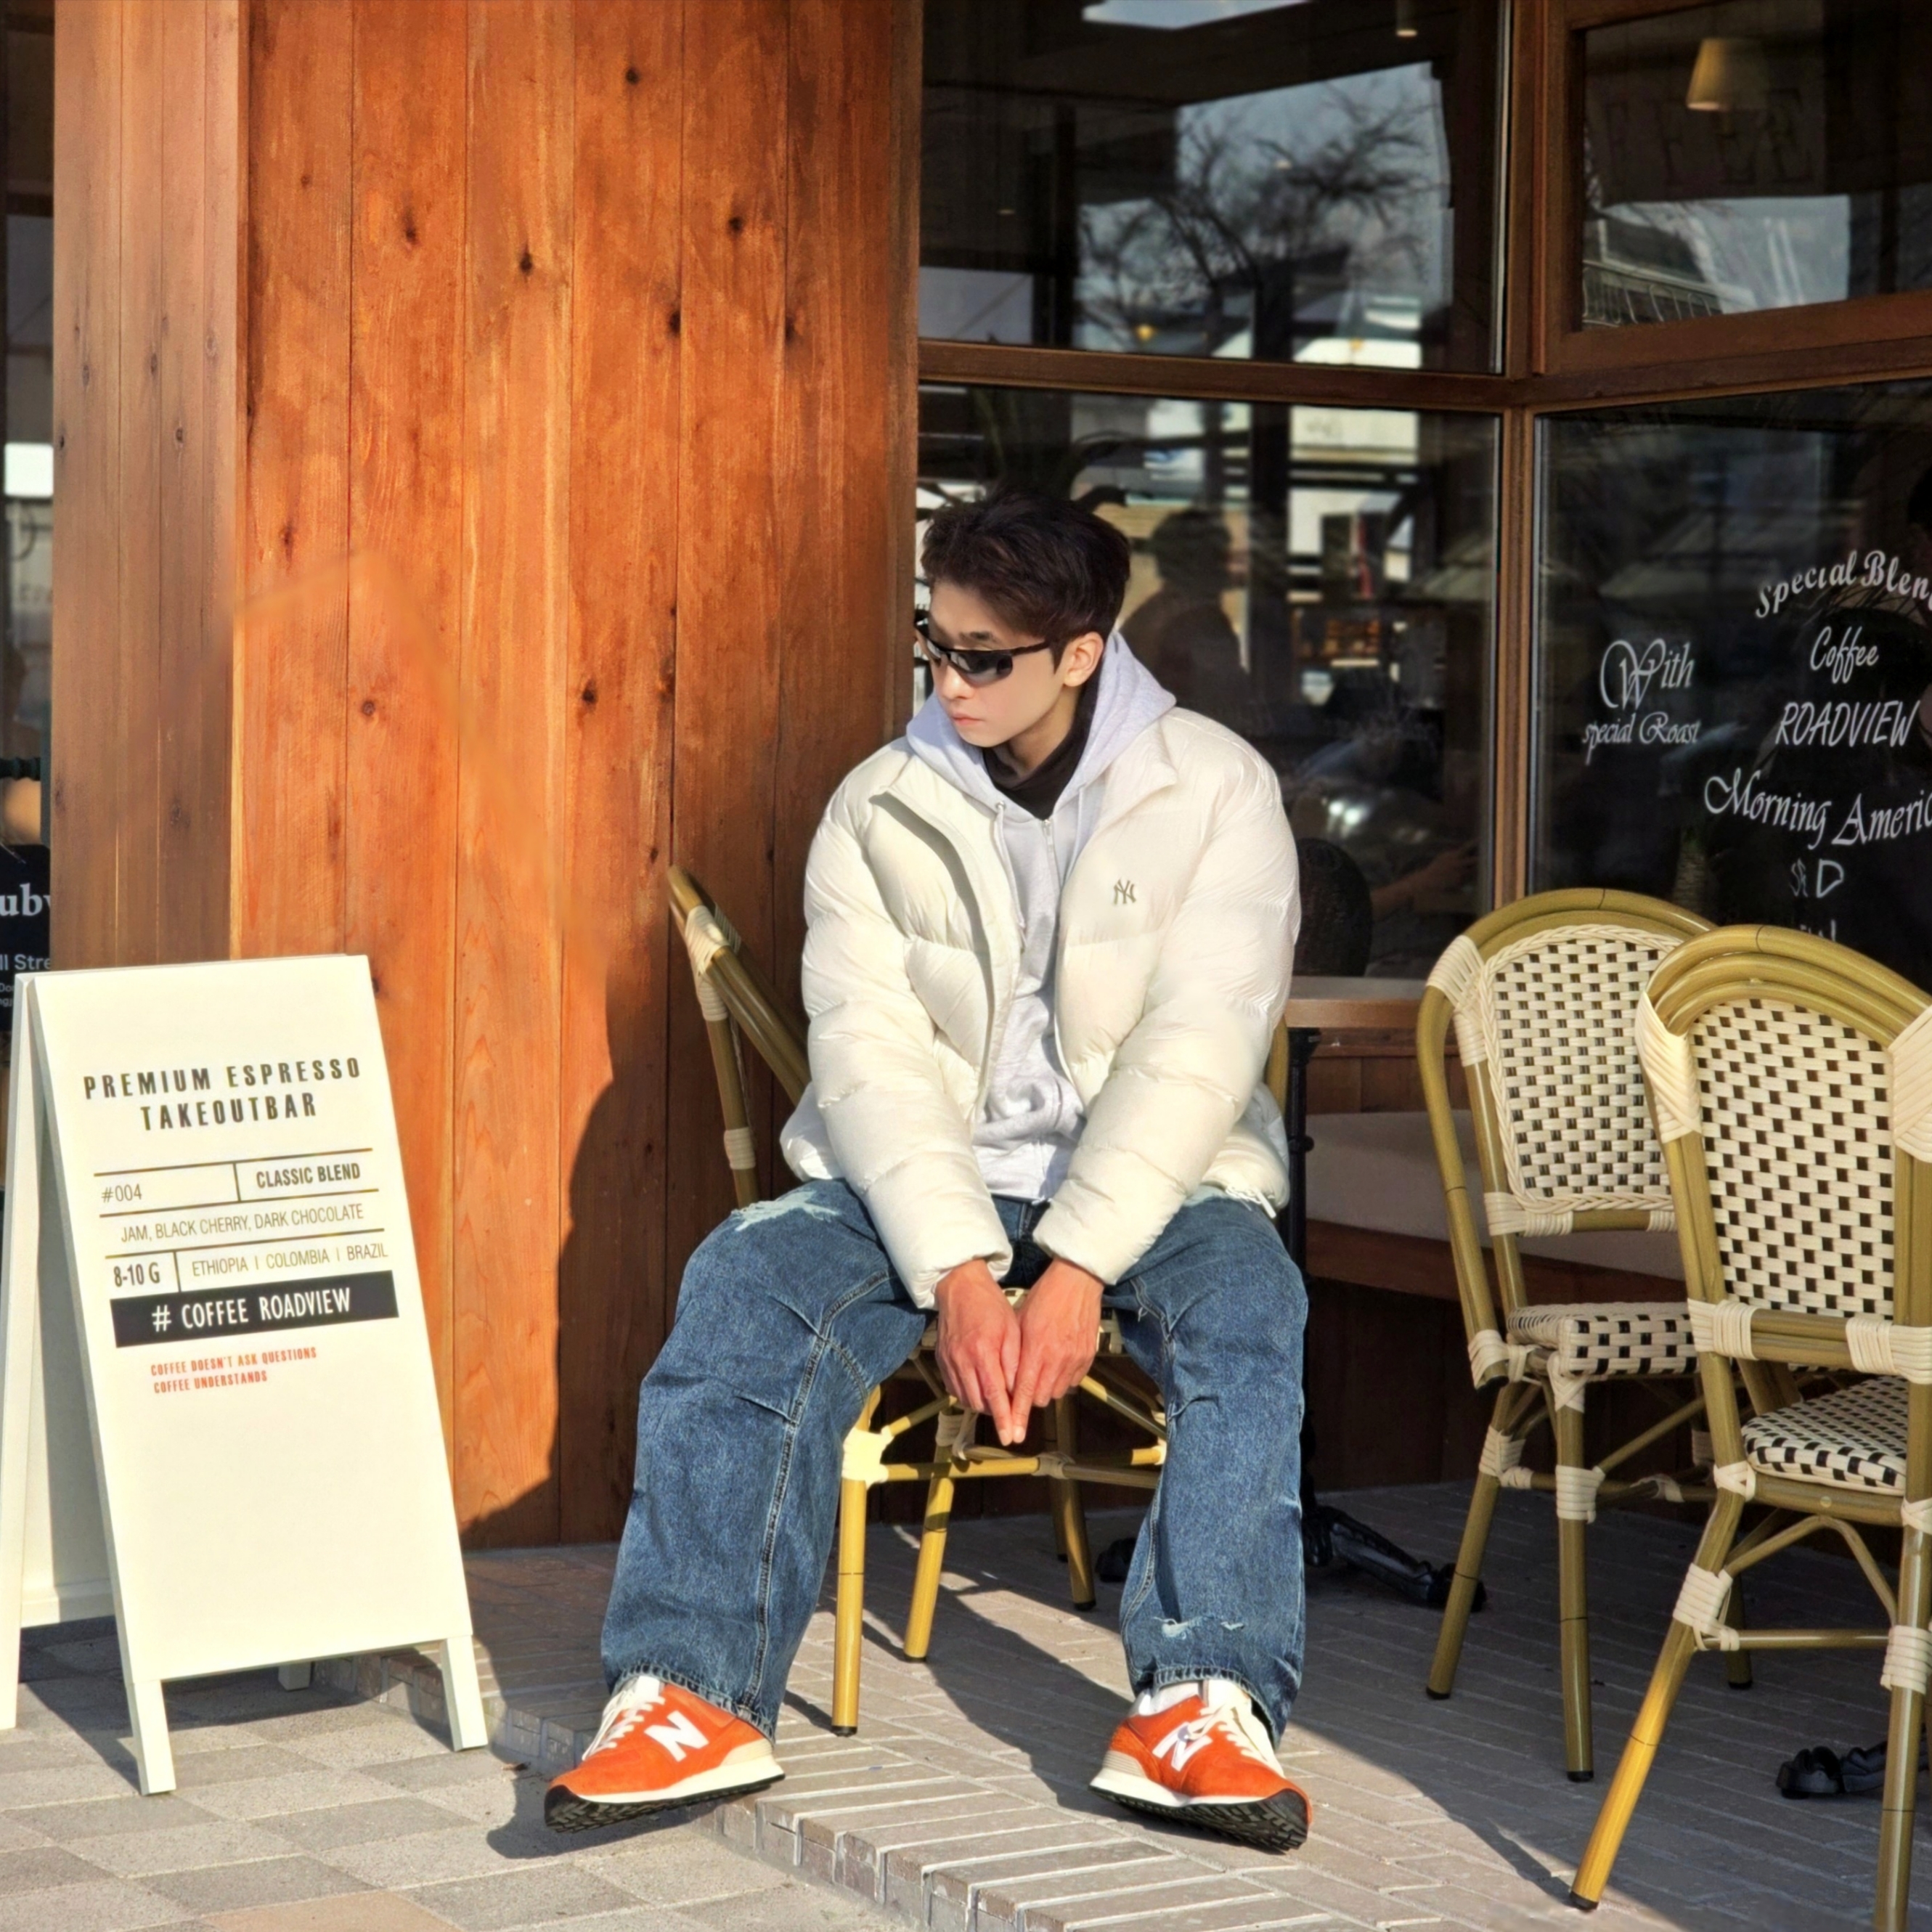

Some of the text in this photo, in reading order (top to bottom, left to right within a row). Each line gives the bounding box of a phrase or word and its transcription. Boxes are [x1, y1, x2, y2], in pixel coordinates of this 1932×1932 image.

[1756, 550, 1858, 618] Special
[1600, 638, 1694, 709] With
[1810, 627, 1878, 684] Coffee
[1639, 712, 1700, 744] Roast
[1774, 701, 1920, 746] ROADVIEW
[1705, 768, 1832, 849] Morning
[1113, 879, 1137, 905] NY
[83, 1058, 359, 1099] PREMIUM ESPRESSO
[141, 1093, 315, 1130] TAKEOUTBAR
[102, 1184, 142, 1202] #004
[256, 1163, 360, 1189] CLASSIC BLEND
[121, 1203, 364, 1243] JAM, BLACK CHERRY, DARK CHOCOLATE
[113, 1262, 160, 1287] 8-10 G
[192, 1257, 248, 1276] ETHIOPIA
[266, 1249, 330, 1268] COLOMBIA
[347, 1243, 388, 1260] BRAZIL
[152, 1288, 349, 1332] # COFFEE ROADVIEW
[151, 1347, 316, 1377] COFFEE DOESN'T ASK QUESTIONS
[154, 1371, 266, 1394] COFFEE UNDERSTANDS
[644, 1710, 709, 1762] N
[1152, 1721, 1213, 1772] N
